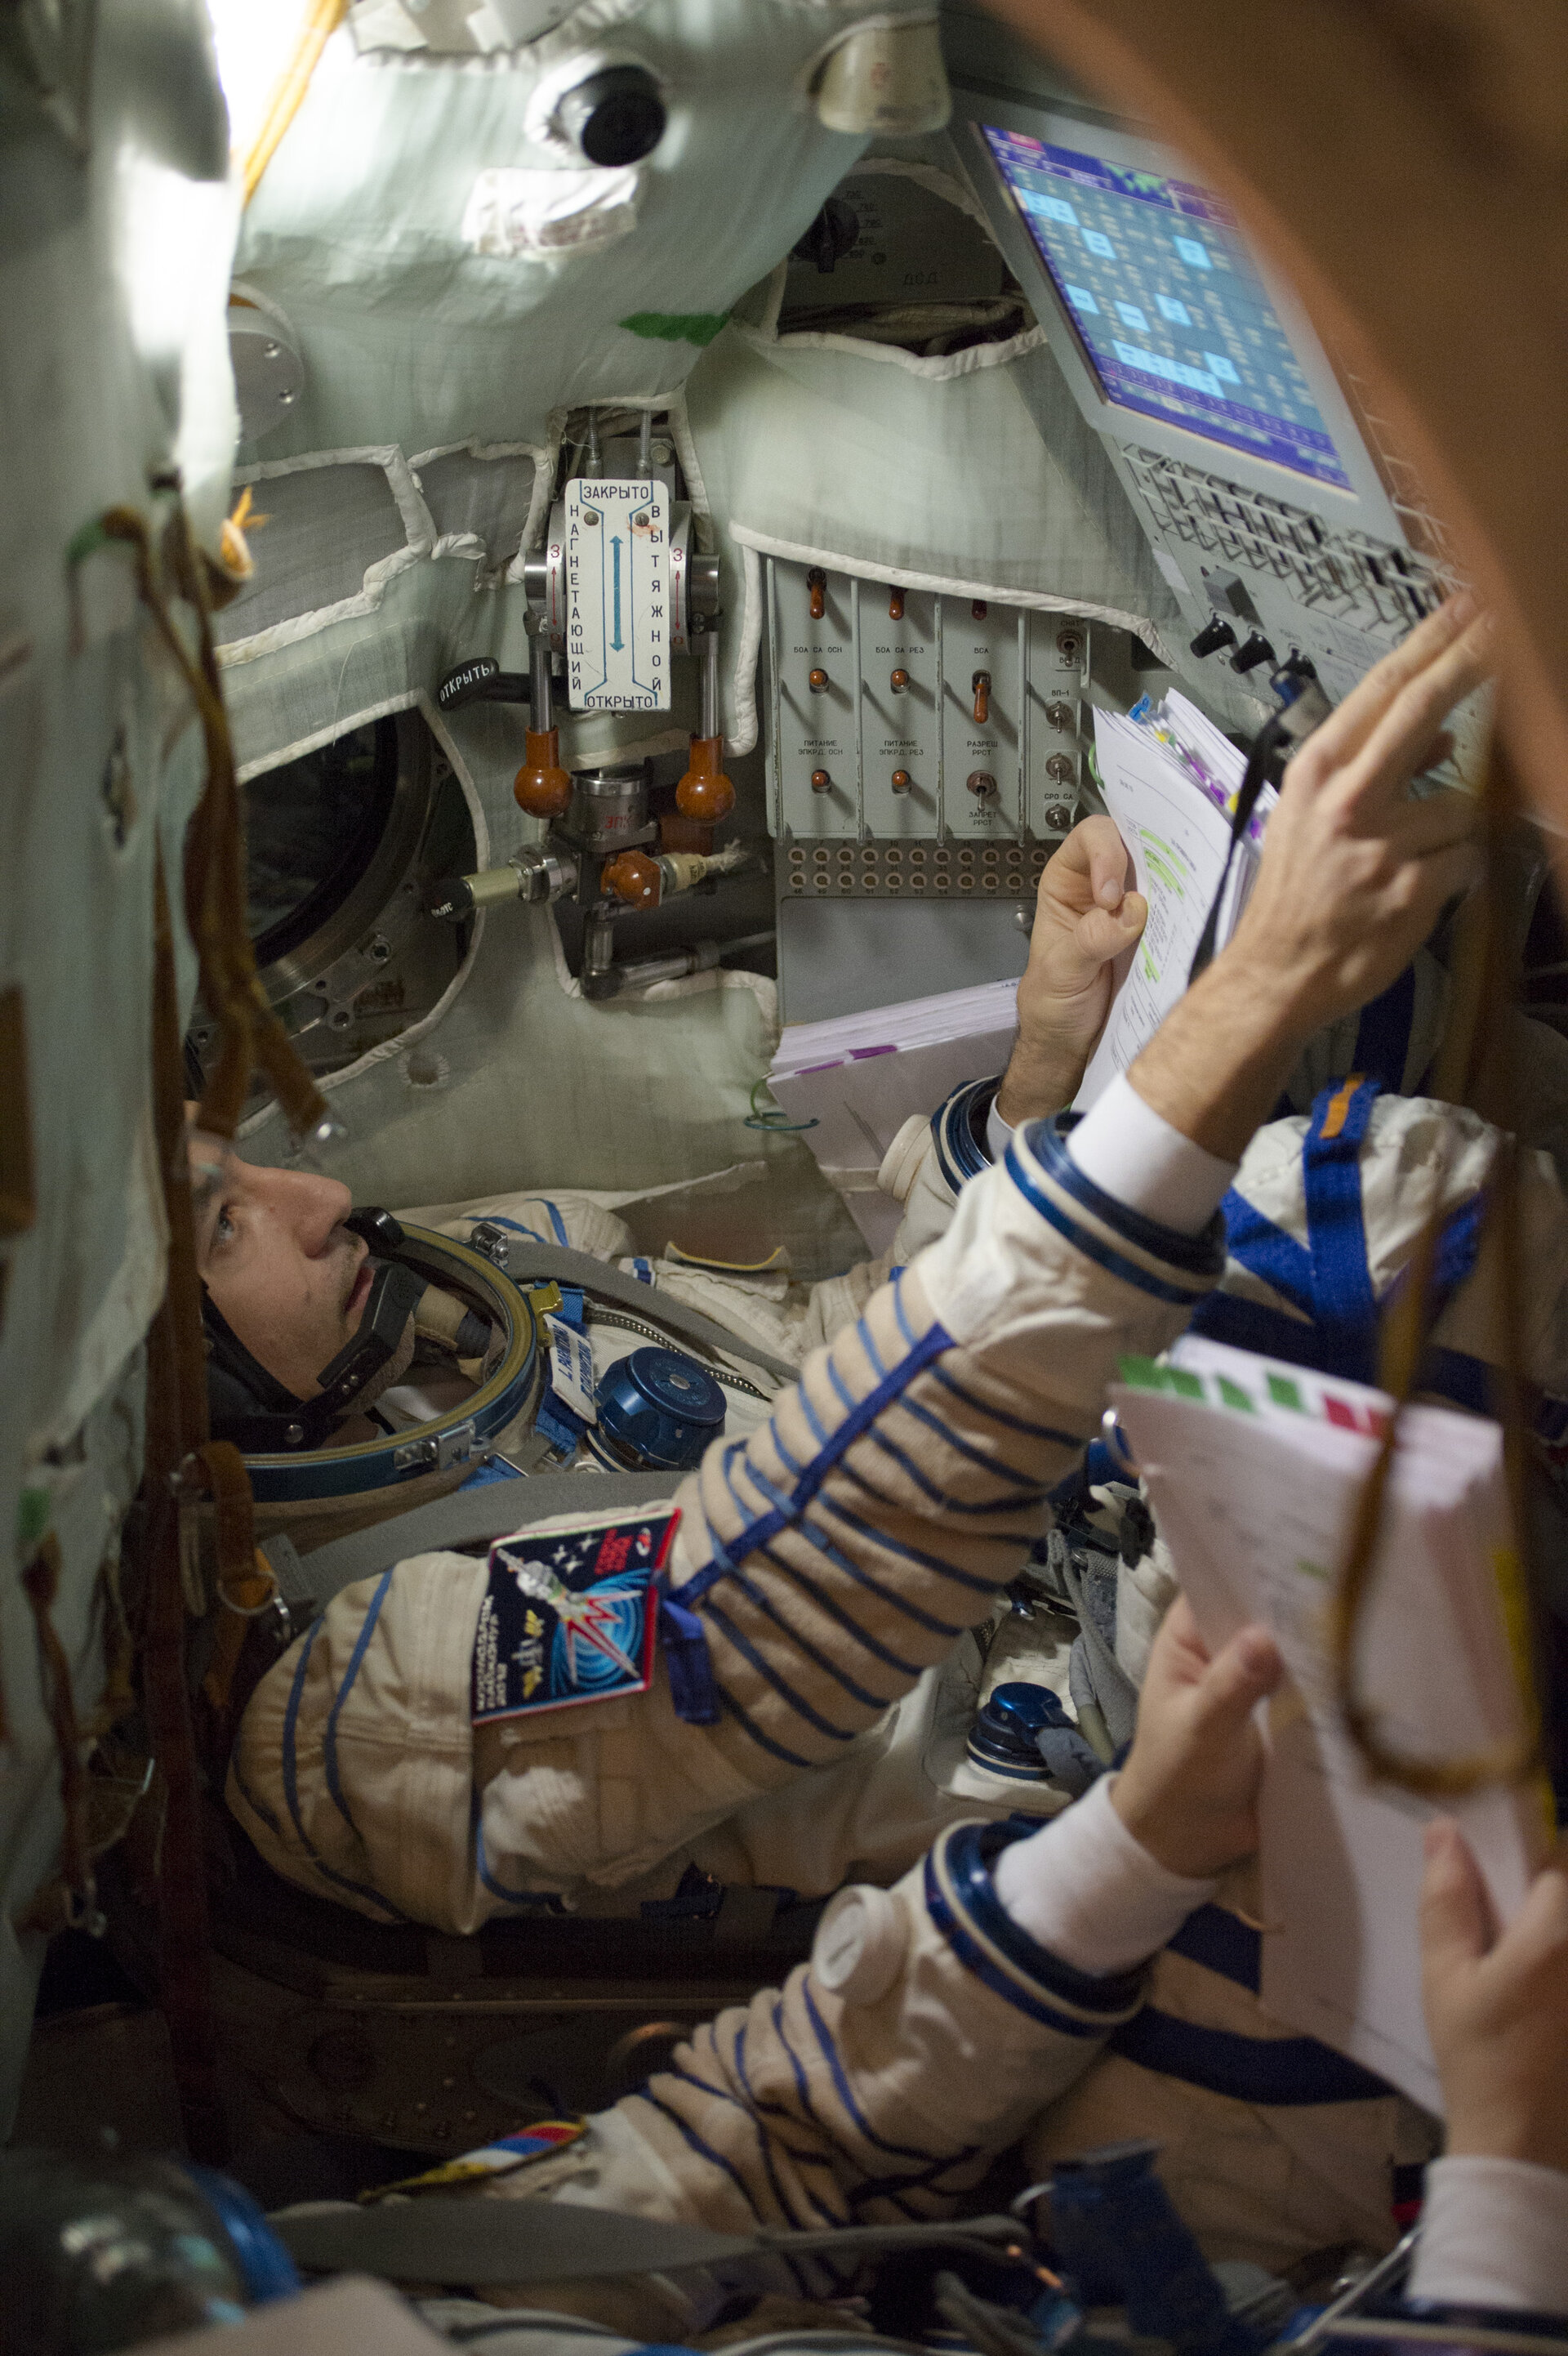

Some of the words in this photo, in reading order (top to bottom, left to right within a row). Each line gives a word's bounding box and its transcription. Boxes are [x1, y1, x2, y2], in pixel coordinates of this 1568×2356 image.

[583, 486, 649, 499] ЗАКРЫТО
[569, 505, 585, 691] НАГНЕТАЮЩИЙ
[650, 506, 664, 692] ВЫТЯЖНОЙ
[439, 664, 490, 702] ОТКРЫТЬ
[586, 696, 653, 709] ОТКРЫТО
